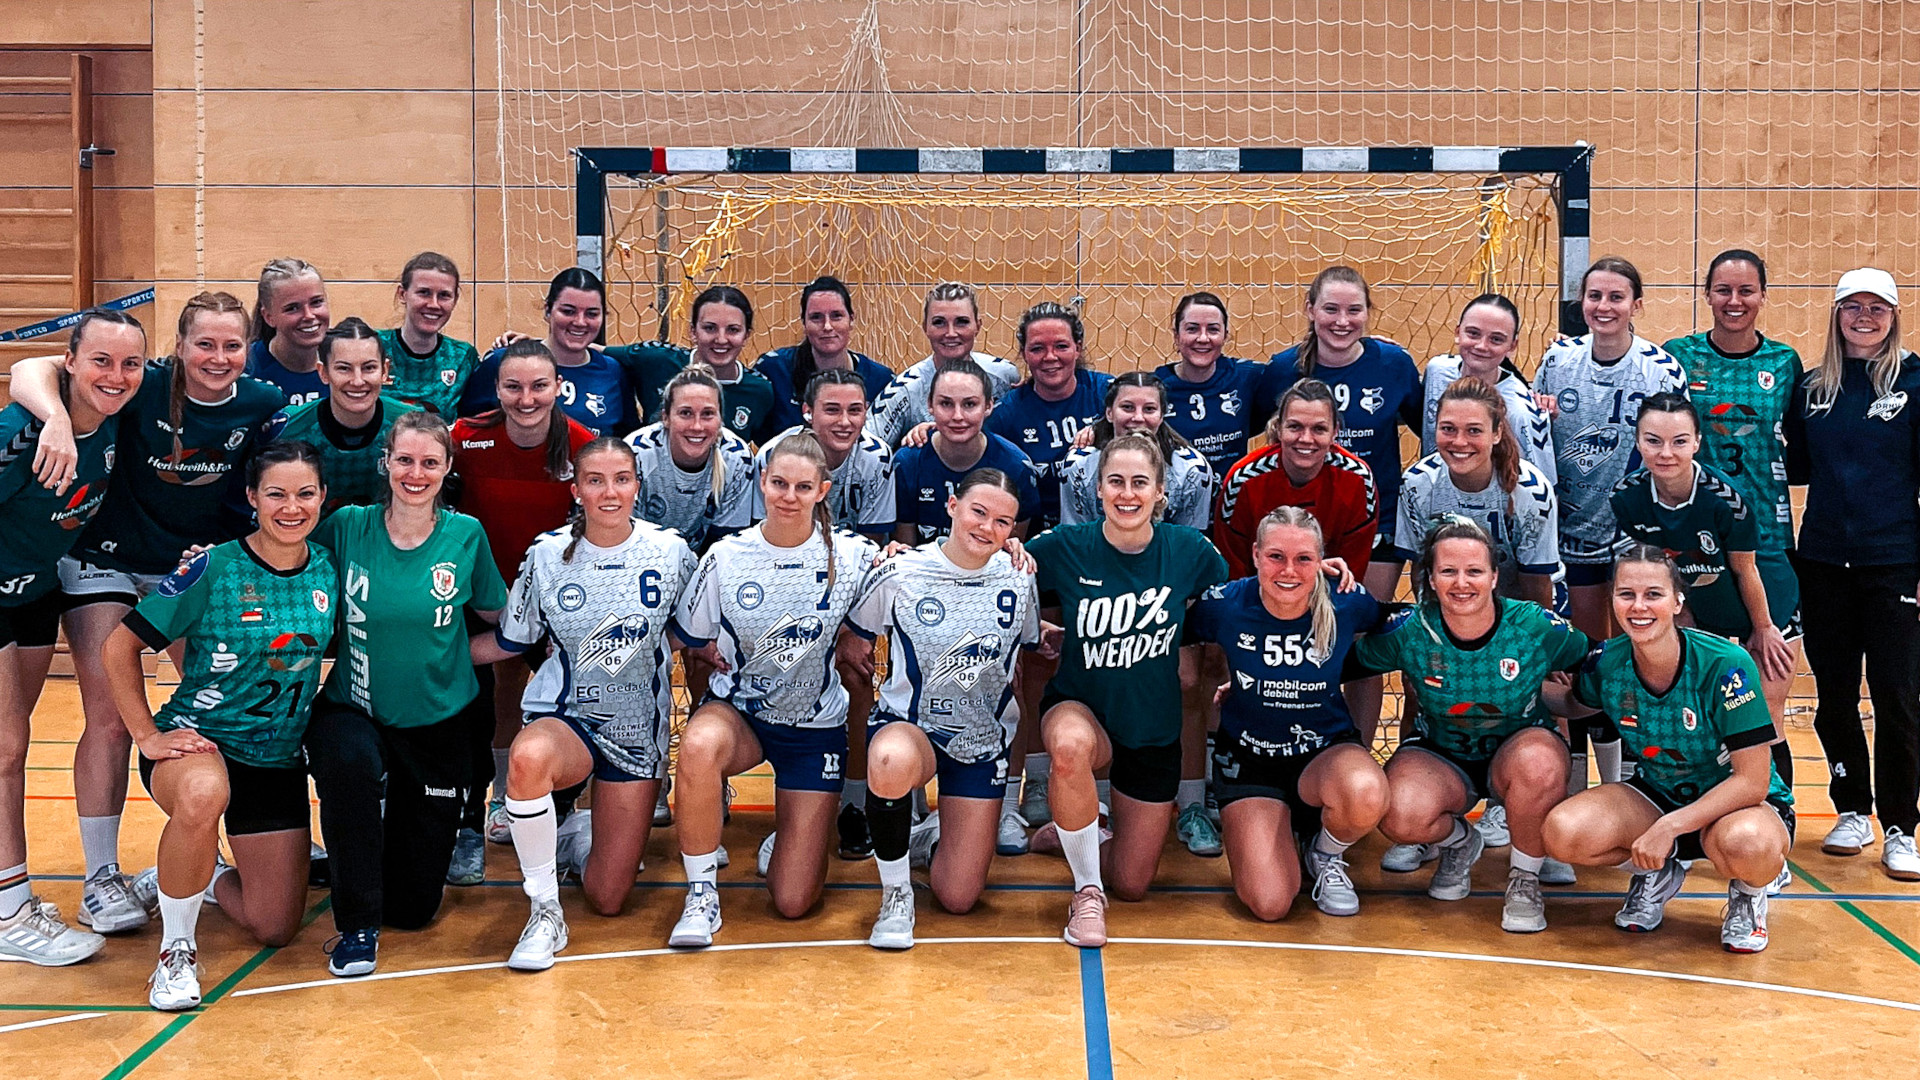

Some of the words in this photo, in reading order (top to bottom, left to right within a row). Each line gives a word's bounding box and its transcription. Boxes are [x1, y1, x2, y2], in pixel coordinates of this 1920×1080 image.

[1189, 393, 1206, 420] 3
[1046, 416, 1078, 449] 10
[1194, 430, 1243, 446] mobilcom
[462, 439, 495, 450] Kempa
[1721, 442, 1744, 477] 3
[638, 569, 662, 609] 6
[816, 569, 838, 611] 7
[433, 604, 454, 628] 12
[996, 589, 1018, 630] 9
[1077, 586, 1172, 638] 100%
[588, 637, 640, 651] DRHV
[764, 637, 812, 649] DRHV
[1082, 623, 1178, 670] WERDER
[1263, 634, 1304, 667] 55
[604, 654, 622, 666] 06
[778, 653, 794, 663] 06
[945, 655, 992, 668] DRHV
[959, 672, 975, 682] 06
[576, 685, 600, 698] EG
[606, 680, 650, 694] Gedack
[1263, 679, 1327, 692] mobilcom
[246, 679, 305, 718] 21
[1262, 689, 1300, 699] debitel
[929, 697, 953, 710] EG
[424, 784, 456, 797] hummel
